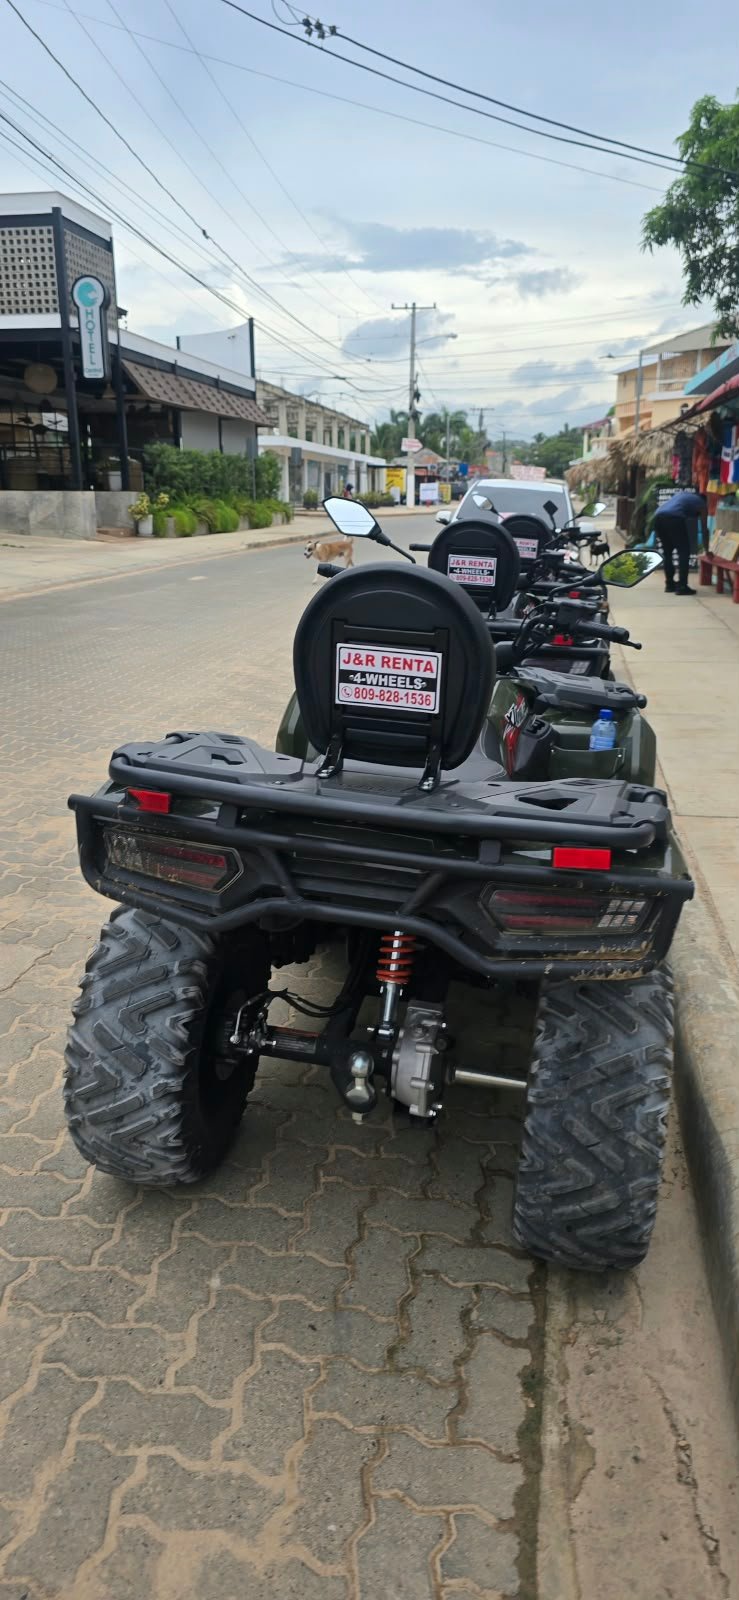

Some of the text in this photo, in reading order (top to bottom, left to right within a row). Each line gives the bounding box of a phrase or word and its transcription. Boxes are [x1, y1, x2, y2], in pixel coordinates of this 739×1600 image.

[85, 309, 96, 365] HOTEL
[450, 559, 493, 568] J&R RENTA
[343, 652, 434, 673] J&R RENTA
[353, 672, 423, 690] 4-WHEELS
[353, 687, 432, 706] 809-828-1536
